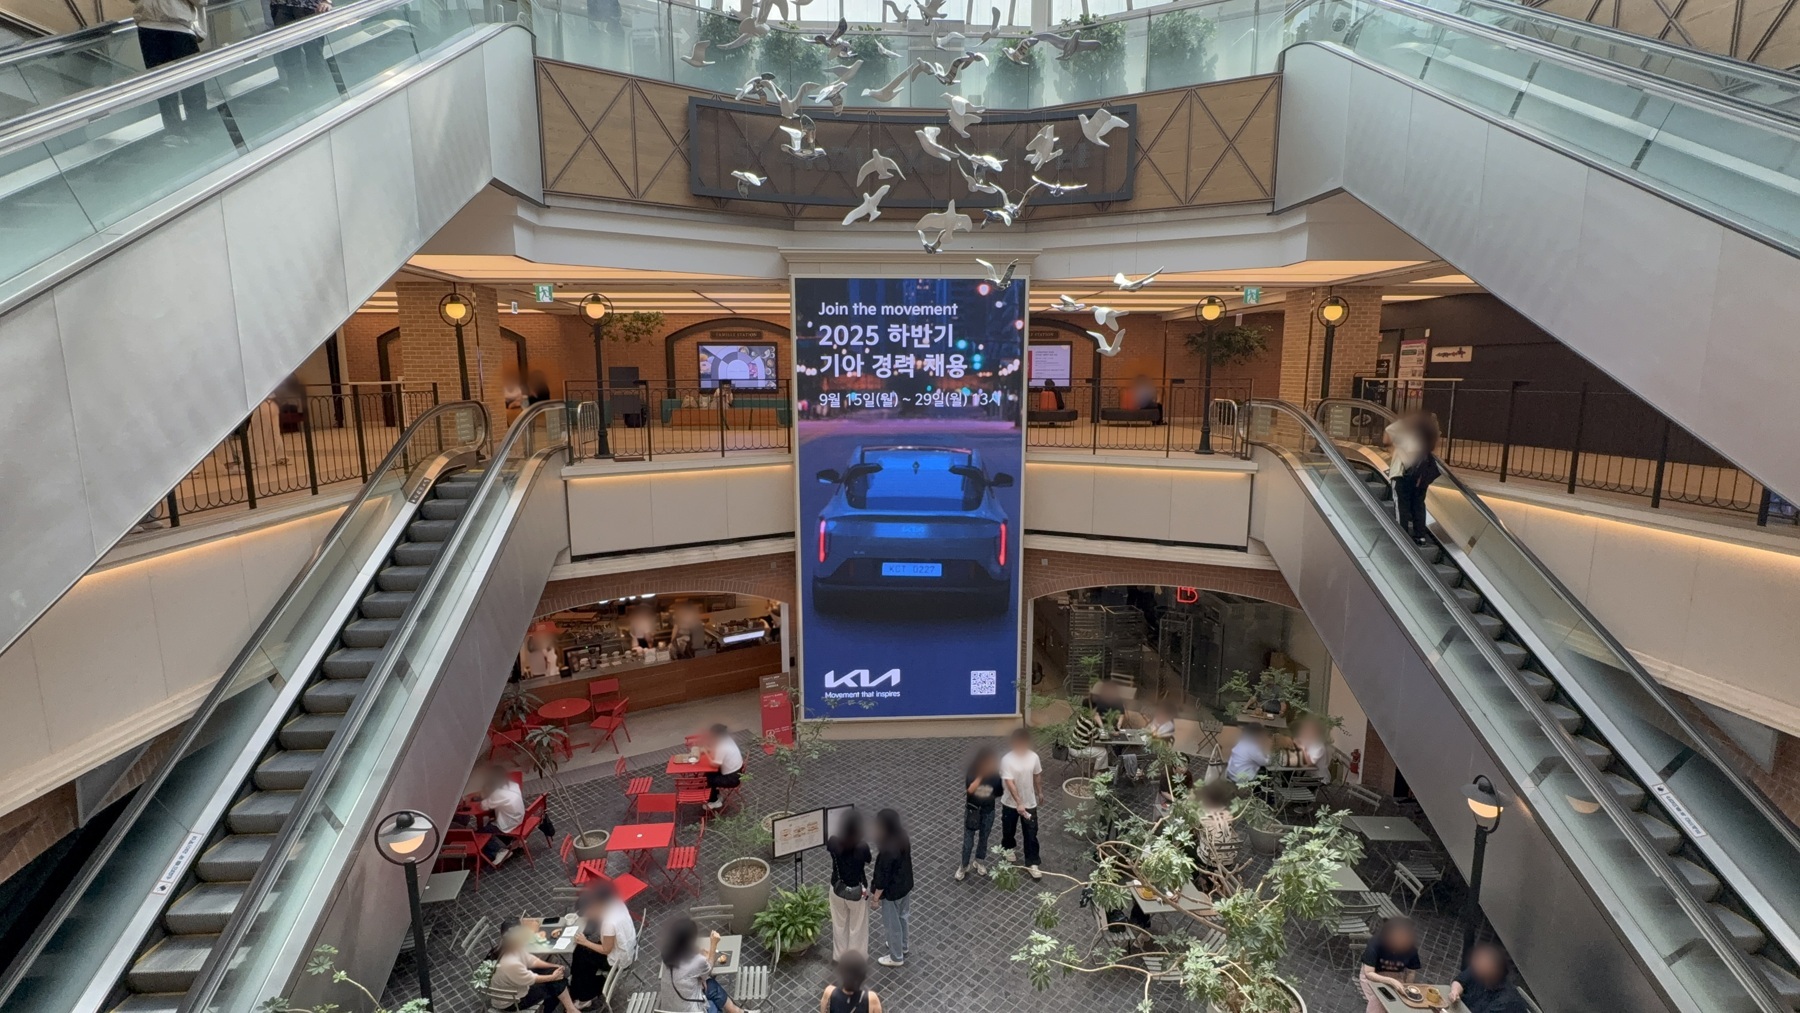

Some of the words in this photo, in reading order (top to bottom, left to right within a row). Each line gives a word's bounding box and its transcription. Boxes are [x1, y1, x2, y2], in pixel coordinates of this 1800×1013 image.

[818, 302, 848, 315] Join
[853, 302, 876, 315] the
[881, 303, 958, 315] movement
[818, 325, 880, 346] 2025
[887, 323, 953, 348] 하반기
[820, 354, 864, 376] 기아
[872, 354, 914, 378] 경력
[923, 354, 967, 378] 채용
[819, 393, 841, 408] 9월
[846, 392, 898, 407] 15일(월)
[915, 392, 968, 407] 29일(월)
[825, 668, 900, 688] KIA
[876, 690, 900, 698] inspires
